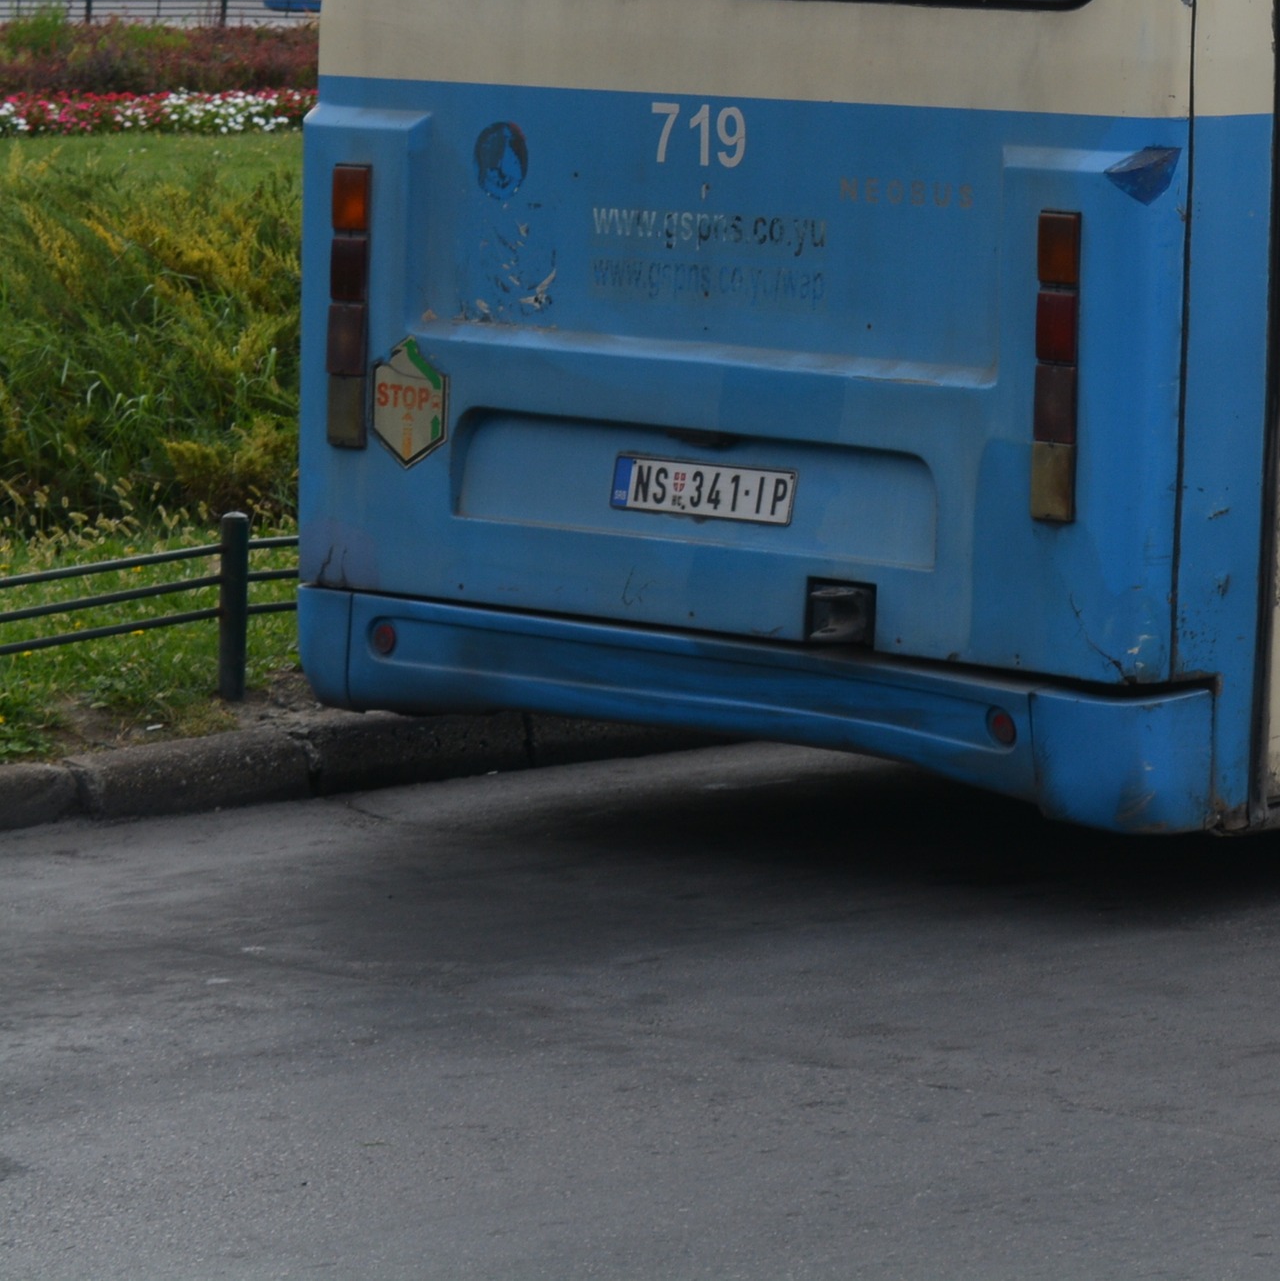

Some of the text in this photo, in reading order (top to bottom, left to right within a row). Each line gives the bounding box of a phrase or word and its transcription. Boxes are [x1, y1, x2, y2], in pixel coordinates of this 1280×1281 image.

[651, 102, 747, 169] 719
[839, 175, 974, 208] NEOBUS
[592, 207, 827, 257] www.gspns.co.yu
[376, 382, 431, 412] STOP
[633, 464, 669, 505] NS
